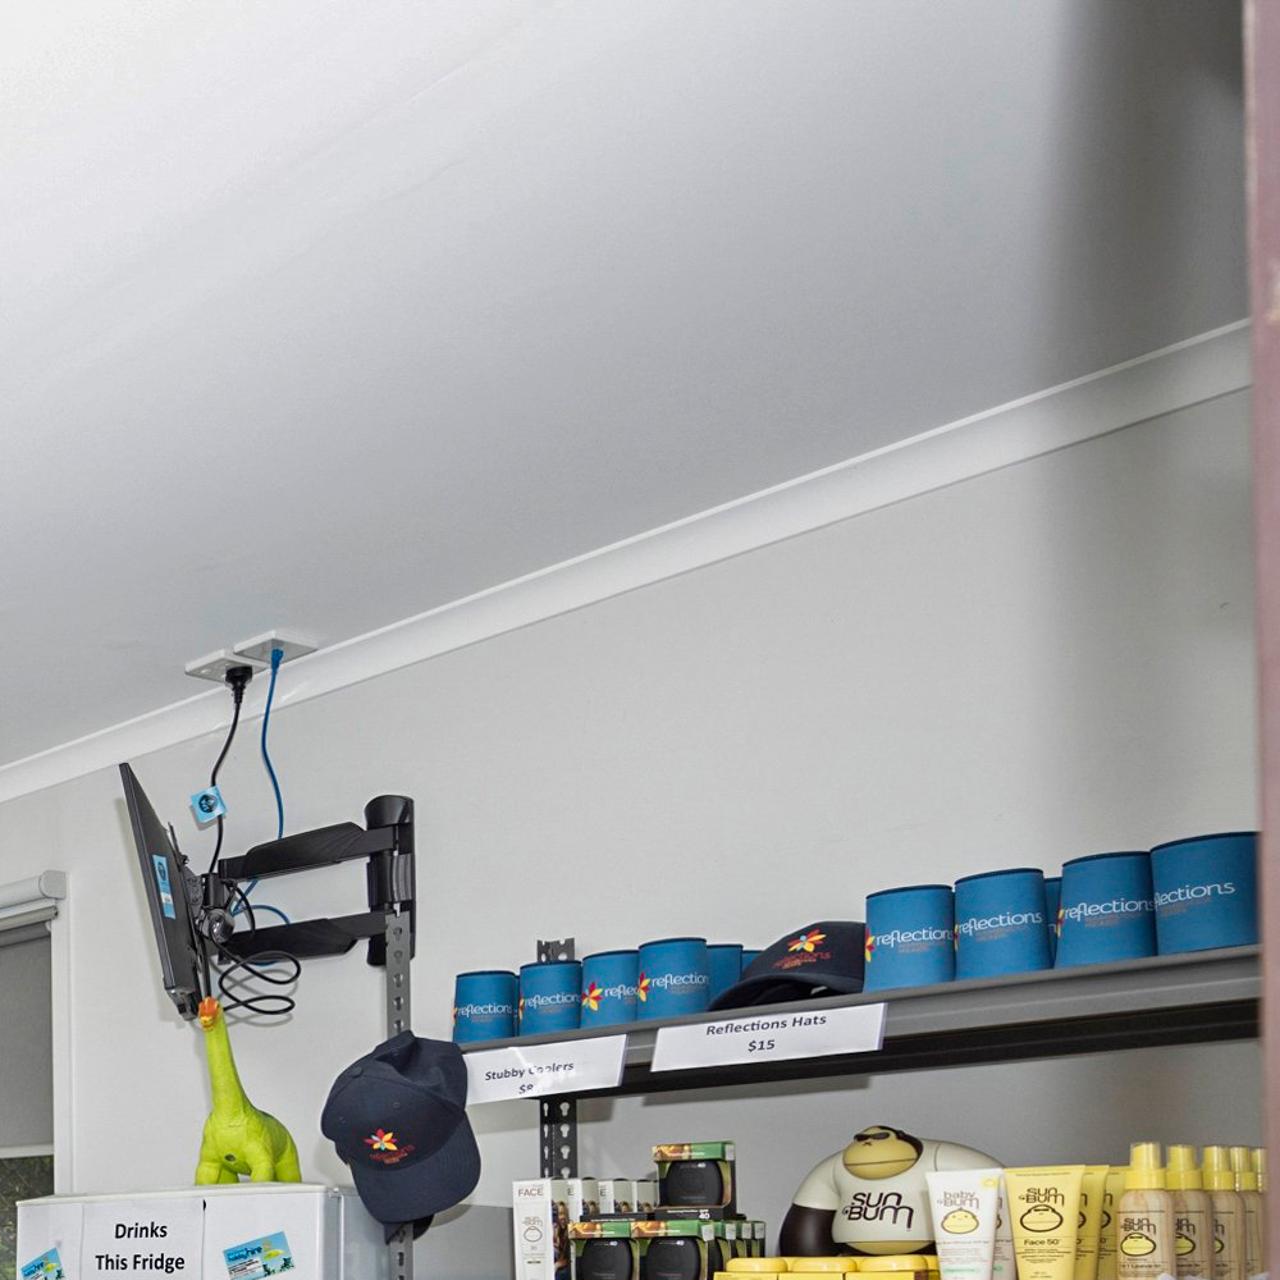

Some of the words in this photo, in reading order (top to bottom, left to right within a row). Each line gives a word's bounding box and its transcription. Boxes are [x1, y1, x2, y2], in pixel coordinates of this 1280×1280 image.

[959, 911, 1043, 936] reflections
[651, 971, 709, 987] reflection
[523, 992, 578, 1009] reflection
[706, 1016, 787, 1035] Reflections
[792, 1013, 827, 1028] Hats
[748, 1039, 775, 1052] $15
[485, 1068, 525, 1081] Stubby
[518, 1186, 544, 1198] FACE
[943, 1189, 976, 1200] baby
[114, 1222, 168, 1239] Drinks
[1024, 1238, 1046, 1246] Face
[95, 1254, 128, 1271] This
[133, 1253, 185, 1274] Fridge
